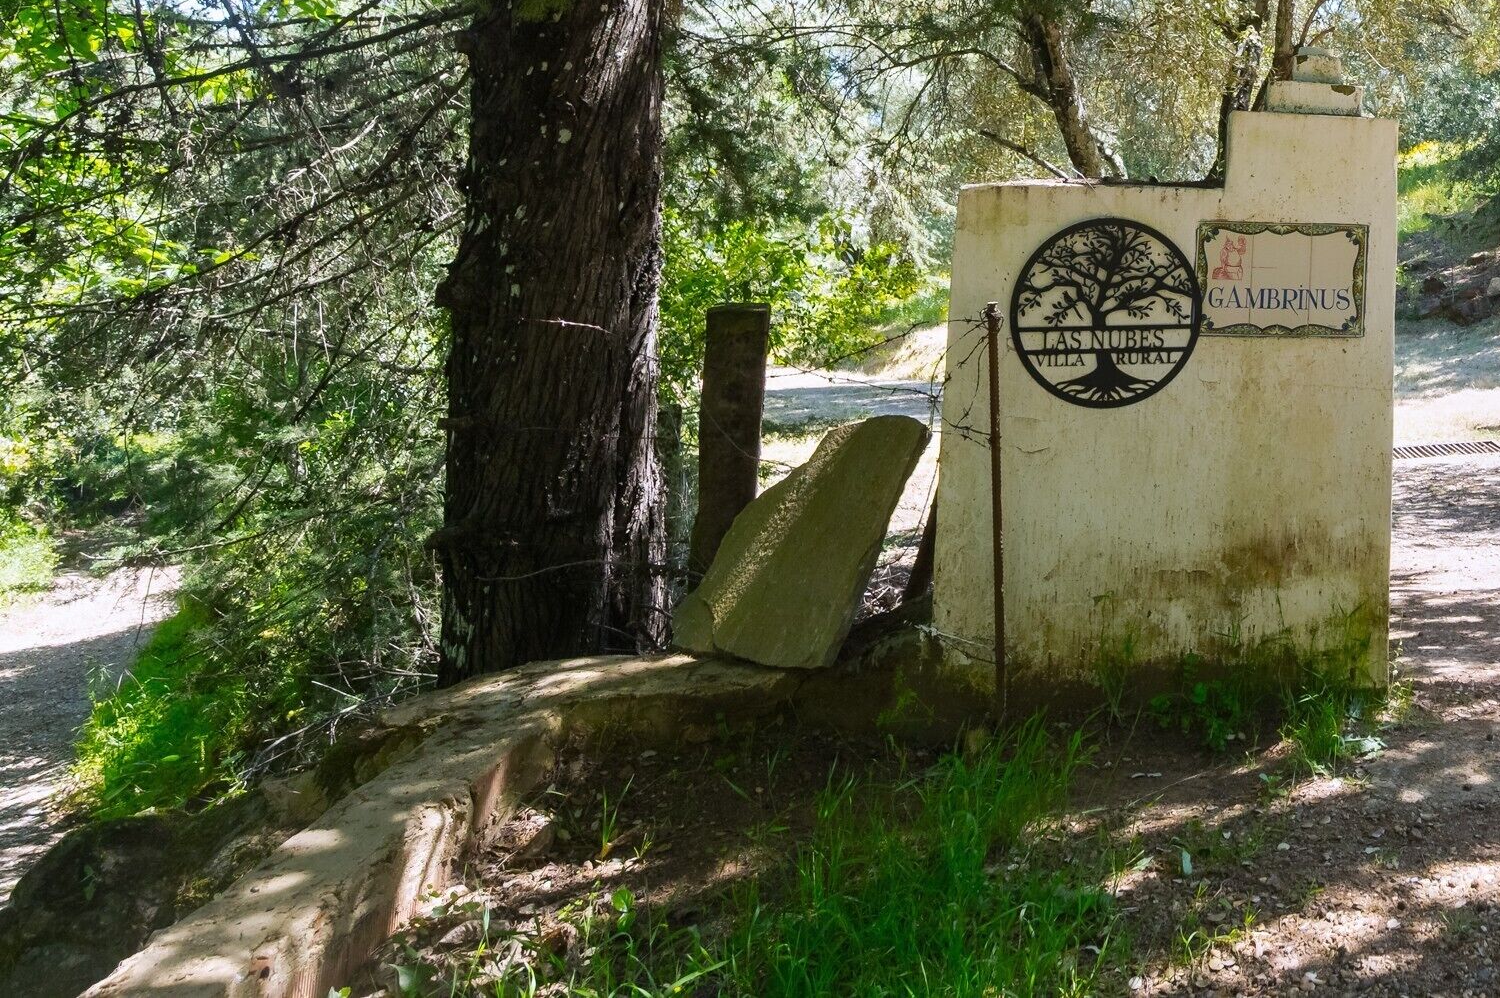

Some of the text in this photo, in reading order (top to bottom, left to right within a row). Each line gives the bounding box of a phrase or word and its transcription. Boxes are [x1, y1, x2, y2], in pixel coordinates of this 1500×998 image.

[1043, 329, 1165, 350] LAS NUBES
[1034, 352, 1177, 367] VILLA RURAL
